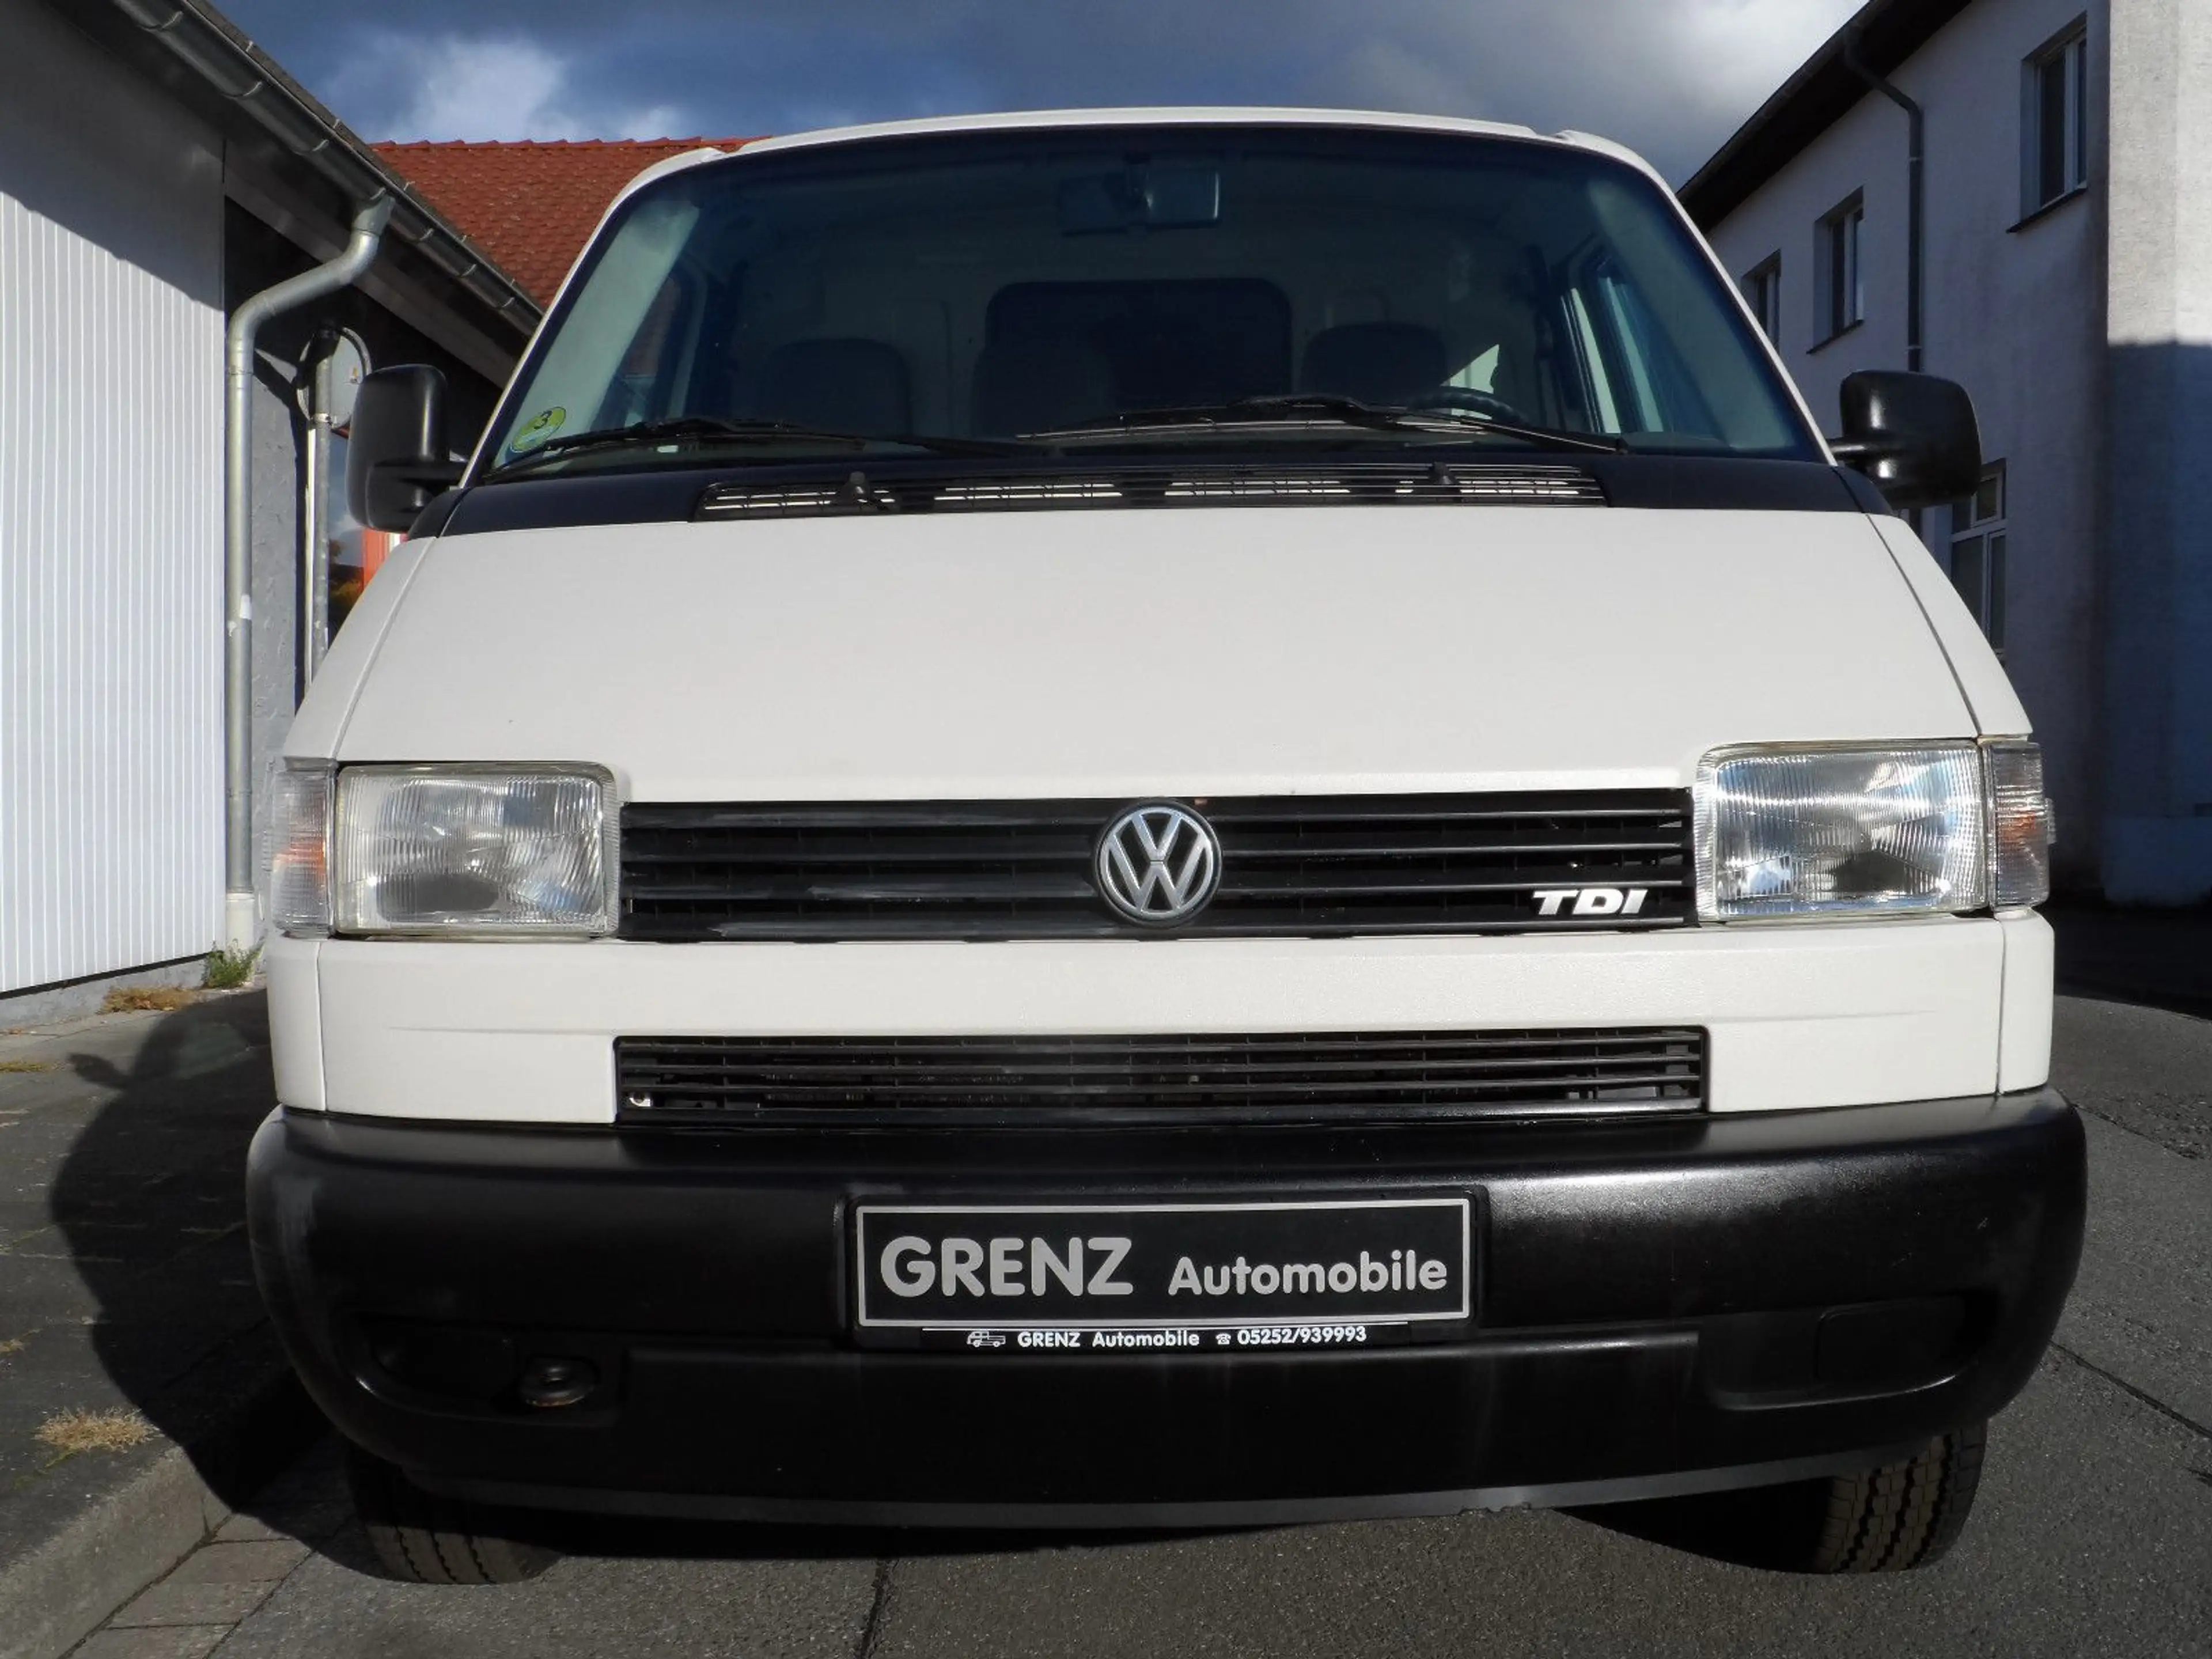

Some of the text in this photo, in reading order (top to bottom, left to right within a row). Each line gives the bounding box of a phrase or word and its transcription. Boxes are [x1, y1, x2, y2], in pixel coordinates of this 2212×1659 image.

[1100, 808, 1213, 920] VW
[1533, 888, 1648, 915] TDI
[880, 1236, 1447, 1297] GRENZ Automobile
[1017, 1325, 1367, 1347] GRENZ Automobile 05252/939993
